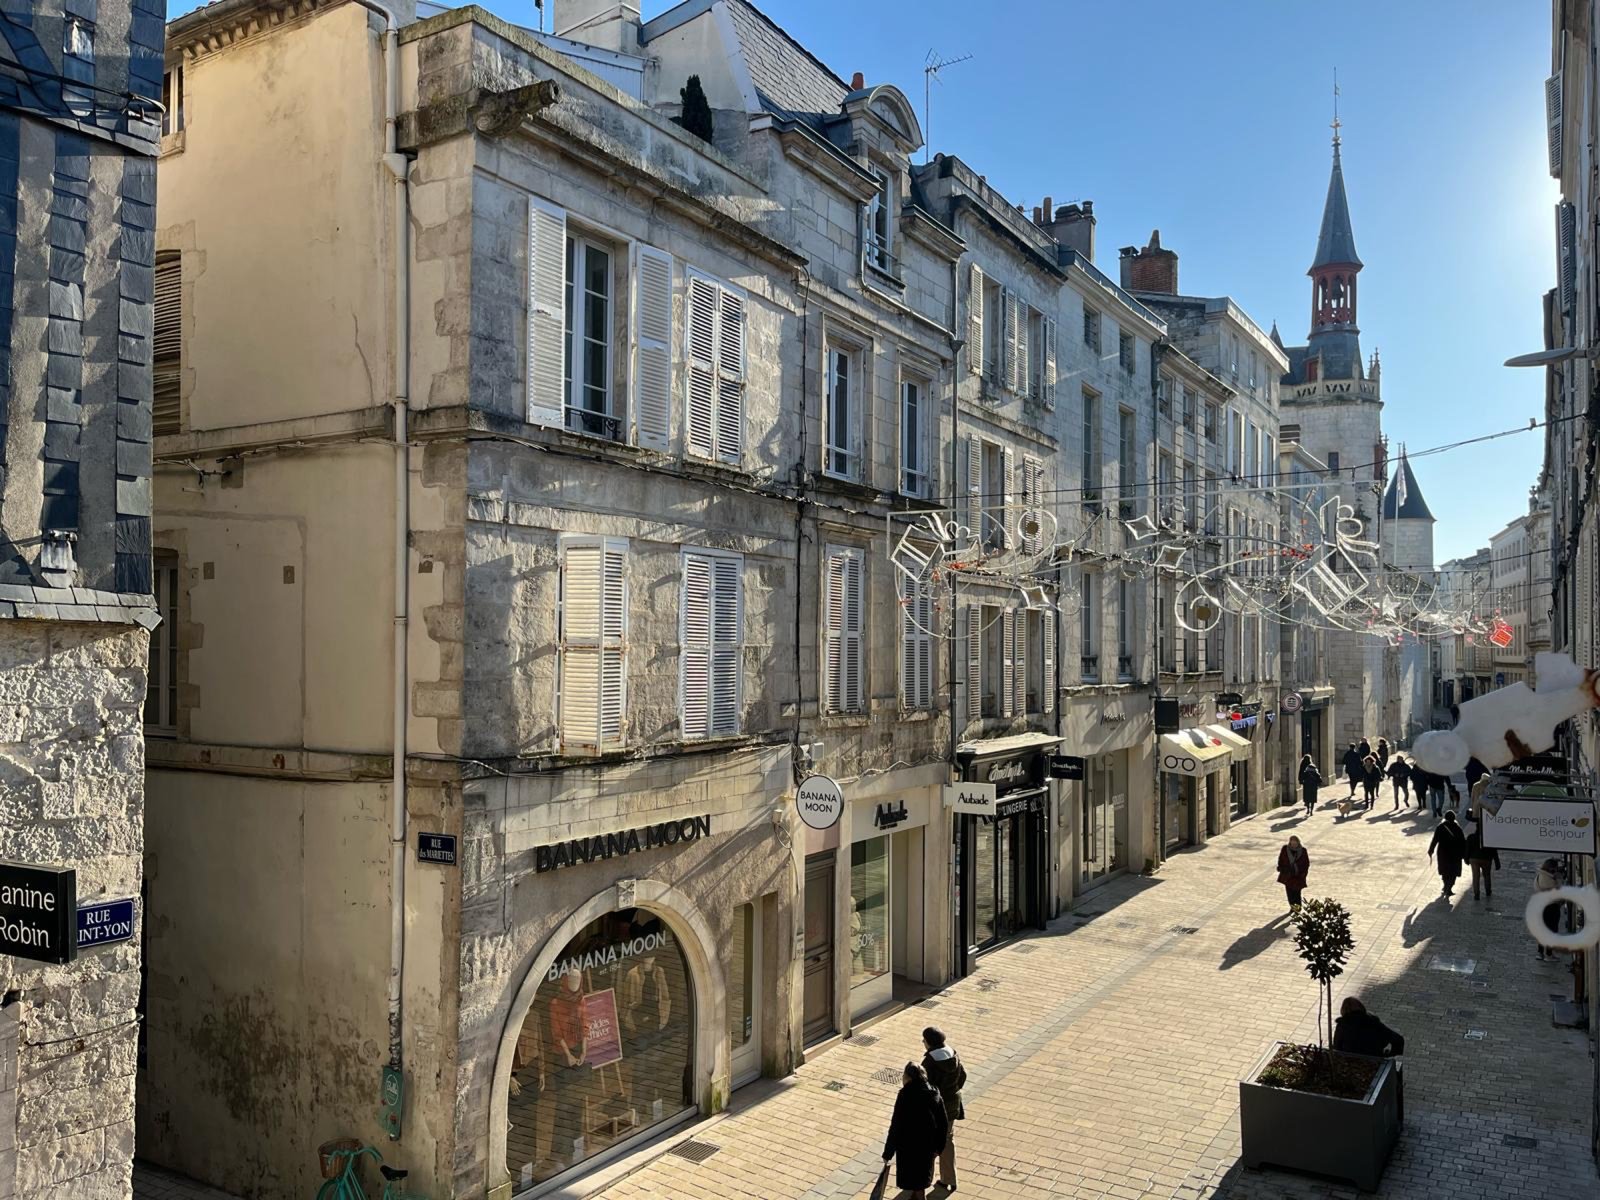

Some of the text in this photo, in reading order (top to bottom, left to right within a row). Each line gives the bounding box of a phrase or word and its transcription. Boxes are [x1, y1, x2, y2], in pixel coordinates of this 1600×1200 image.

[800, 791, 837, 803] BANANA
[958, 792, 989, 806] Aubade
[805, 802, 833, 813] MOON
[1002, 799, 1028, 816] LINGERIE
[1485, 813, 1569, 827] Mademoiselle
[1539, 826, 1586, 841] Bonjour
[431, 838, 442, 849] RUE
[536, 813, 711, 874] BANANA MOON
[1, 882, 56, 912] anine
[86, 909, 111, 926] RUE
[0, 915, 50, 949] Robin
[77, 920, 131, 943] INT-YON
[548, 930, 666, 982] BANANA MOON
